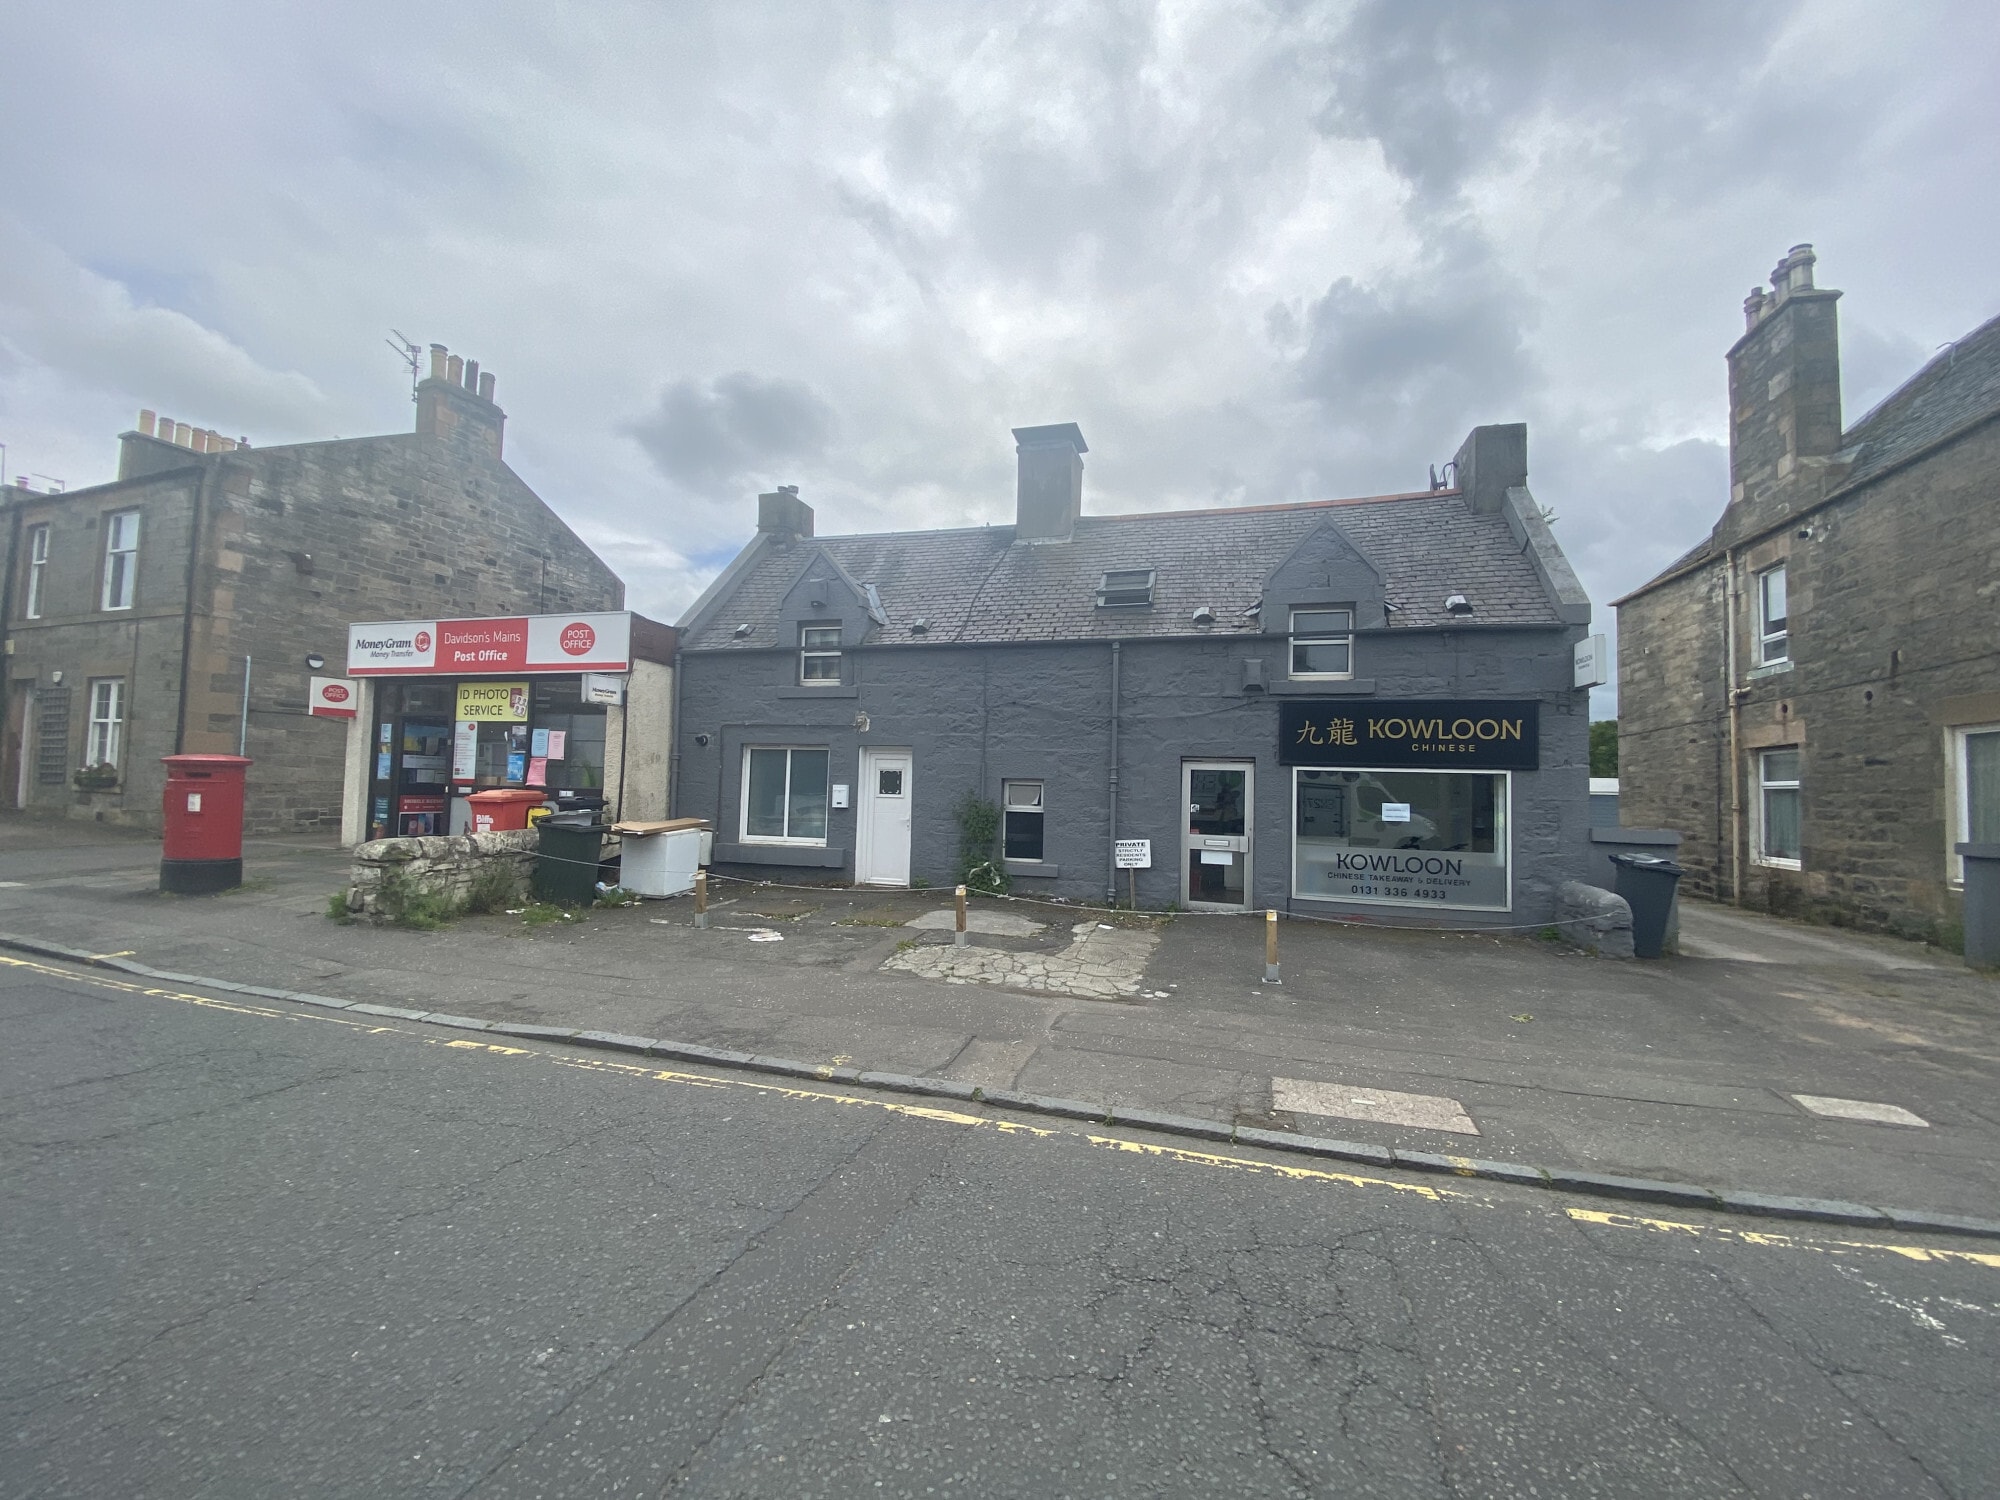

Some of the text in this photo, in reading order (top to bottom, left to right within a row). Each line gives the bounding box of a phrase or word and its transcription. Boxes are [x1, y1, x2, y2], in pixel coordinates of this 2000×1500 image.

[444, 630, 521, 645] Davidson's Mains
[567, 629, 590, 639] POST
[355, 638, 412, 651] MoneyGram
[563, 639, 592, 650] OFFICE
[370, 649, 414, 660] Money Transfer
[453, 650, 508, 662] Post Office
[459, 688, 509, 701] ID PHOTO
[463, 704, 504, 716] SERVICE
[1295, 717, 1358, 746] 九龍
[1368, 718, 1523, 740] KOWLOON
[1411, 743, 1477, 753] CHINESE
[1336, 853, 1462, 875] KOWLOON
[1327, 872, 1365, 881] CHINESE
[1368, 874, 1414, 884] TAKEAWAY
[1426, 878, 1471, 887] DELIVERY
[1351, 885, 1446, 899] 0131 336 4933
